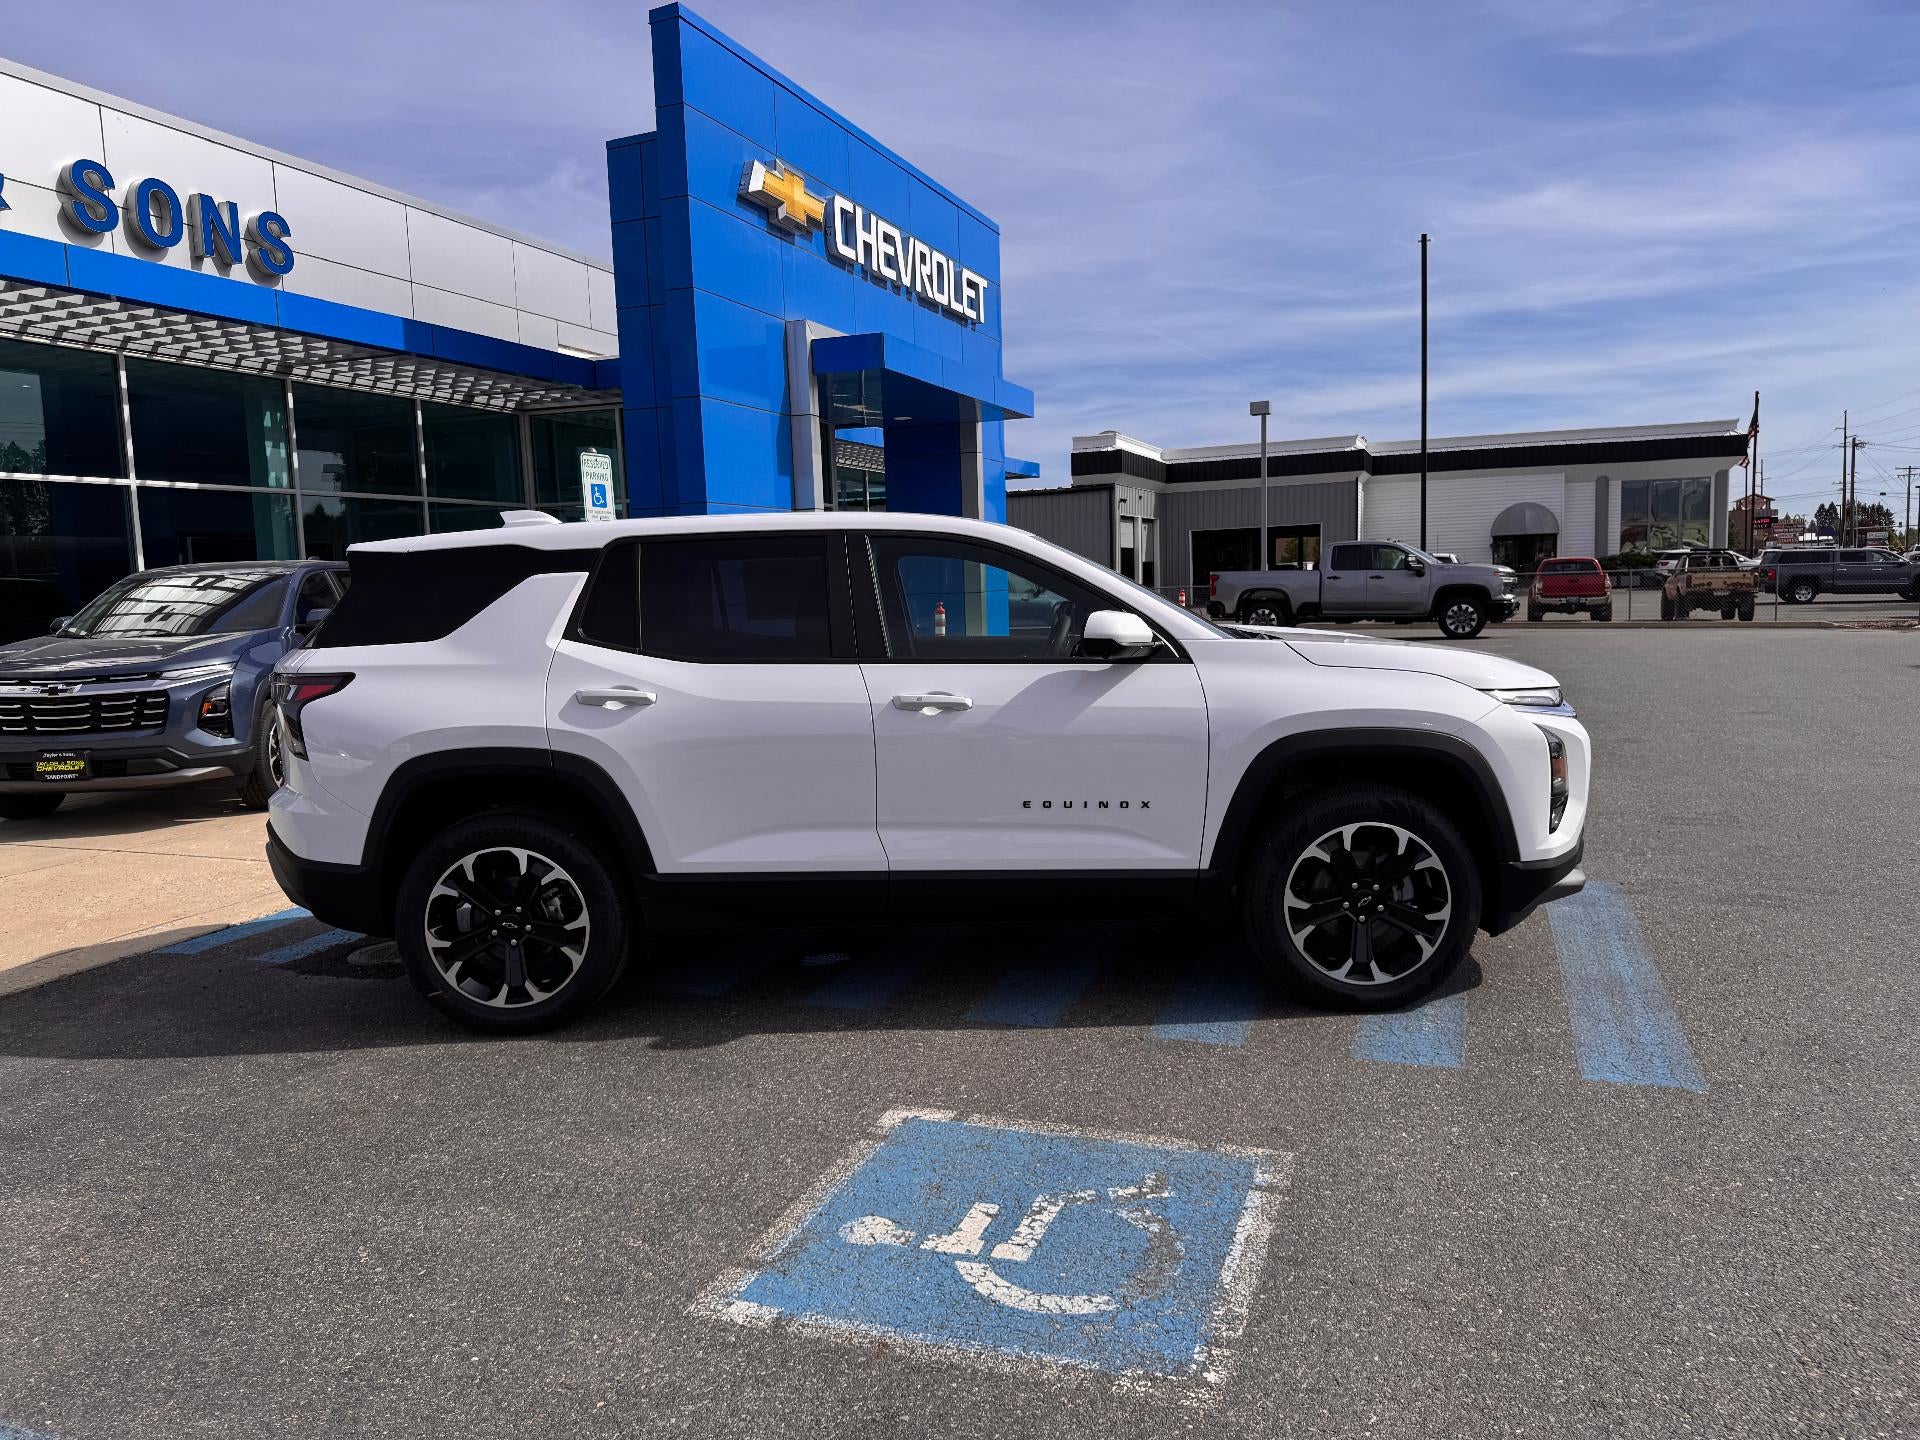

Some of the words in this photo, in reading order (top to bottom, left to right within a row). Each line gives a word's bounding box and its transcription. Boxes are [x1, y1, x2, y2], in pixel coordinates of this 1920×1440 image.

[62, 158, 295, 276] SONS
[833, 194, 988, 324] CHEVROLET
[583, 458, 609, 470] RESERVED
[585, 471, 609, 482] PARKING
[1023, 800, 1151, 809] EQUINOX
